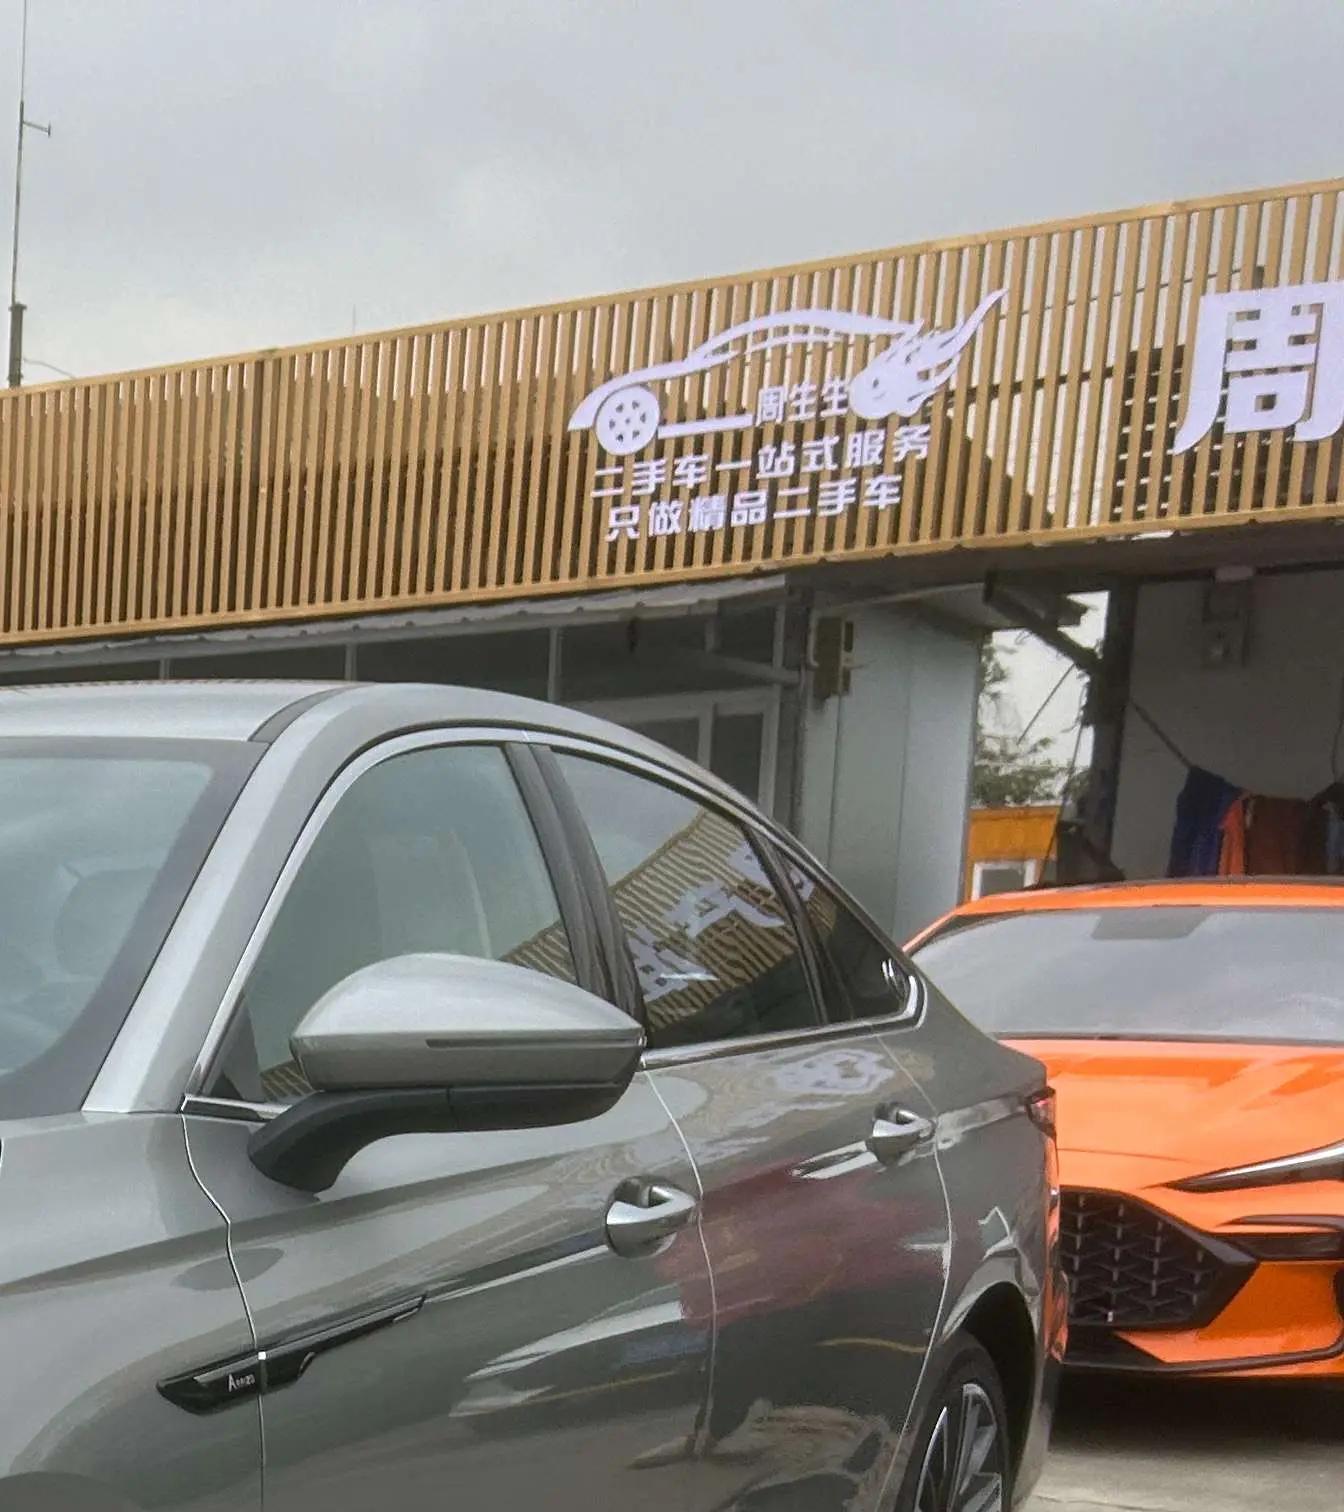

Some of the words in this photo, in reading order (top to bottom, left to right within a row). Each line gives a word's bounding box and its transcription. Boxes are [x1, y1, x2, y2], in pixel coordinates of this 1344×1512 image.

[756, 376, 849, 427] 周生生
[1173, 280, 1344, 456] 周
[591, 423, 931, 498] 二手车一站式服务
[605, 475, 902, 542] 只做精品二手车
